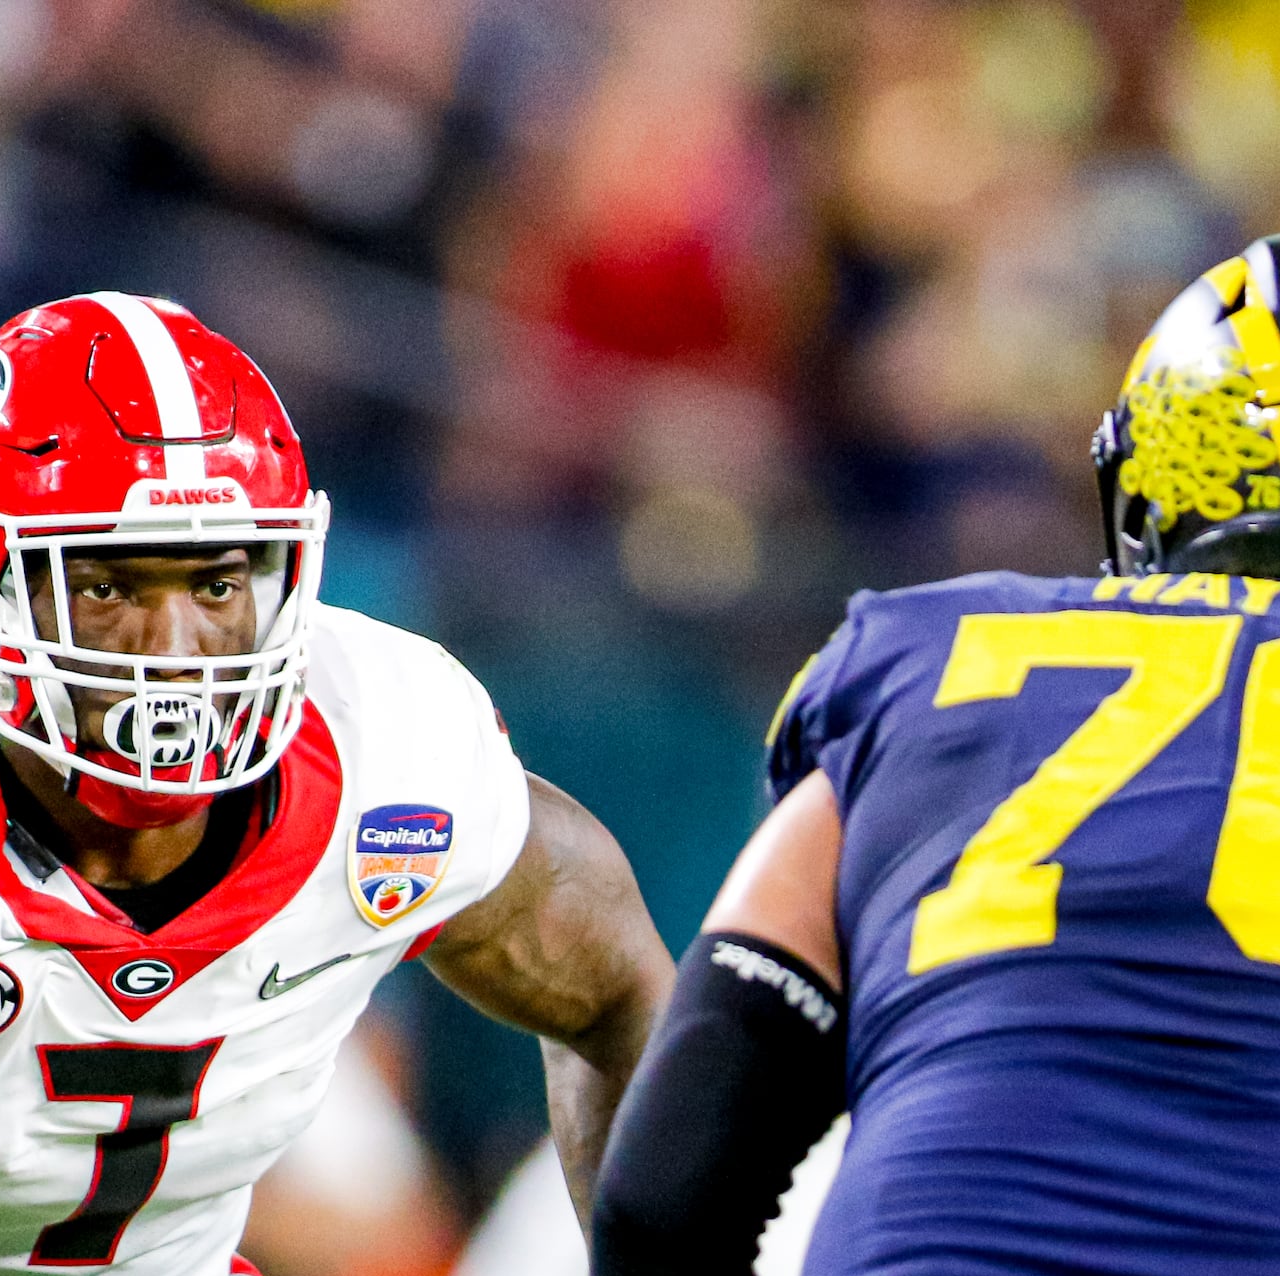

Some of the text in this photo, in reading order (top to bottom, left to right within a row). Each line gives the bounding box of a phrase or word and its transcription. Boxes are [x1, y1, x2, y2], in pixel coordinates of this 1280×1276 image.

[149, 487, 236, 505] DAWGS
[113, 960, 174, 997] G
[27, 1034, 227, 1266] 7
